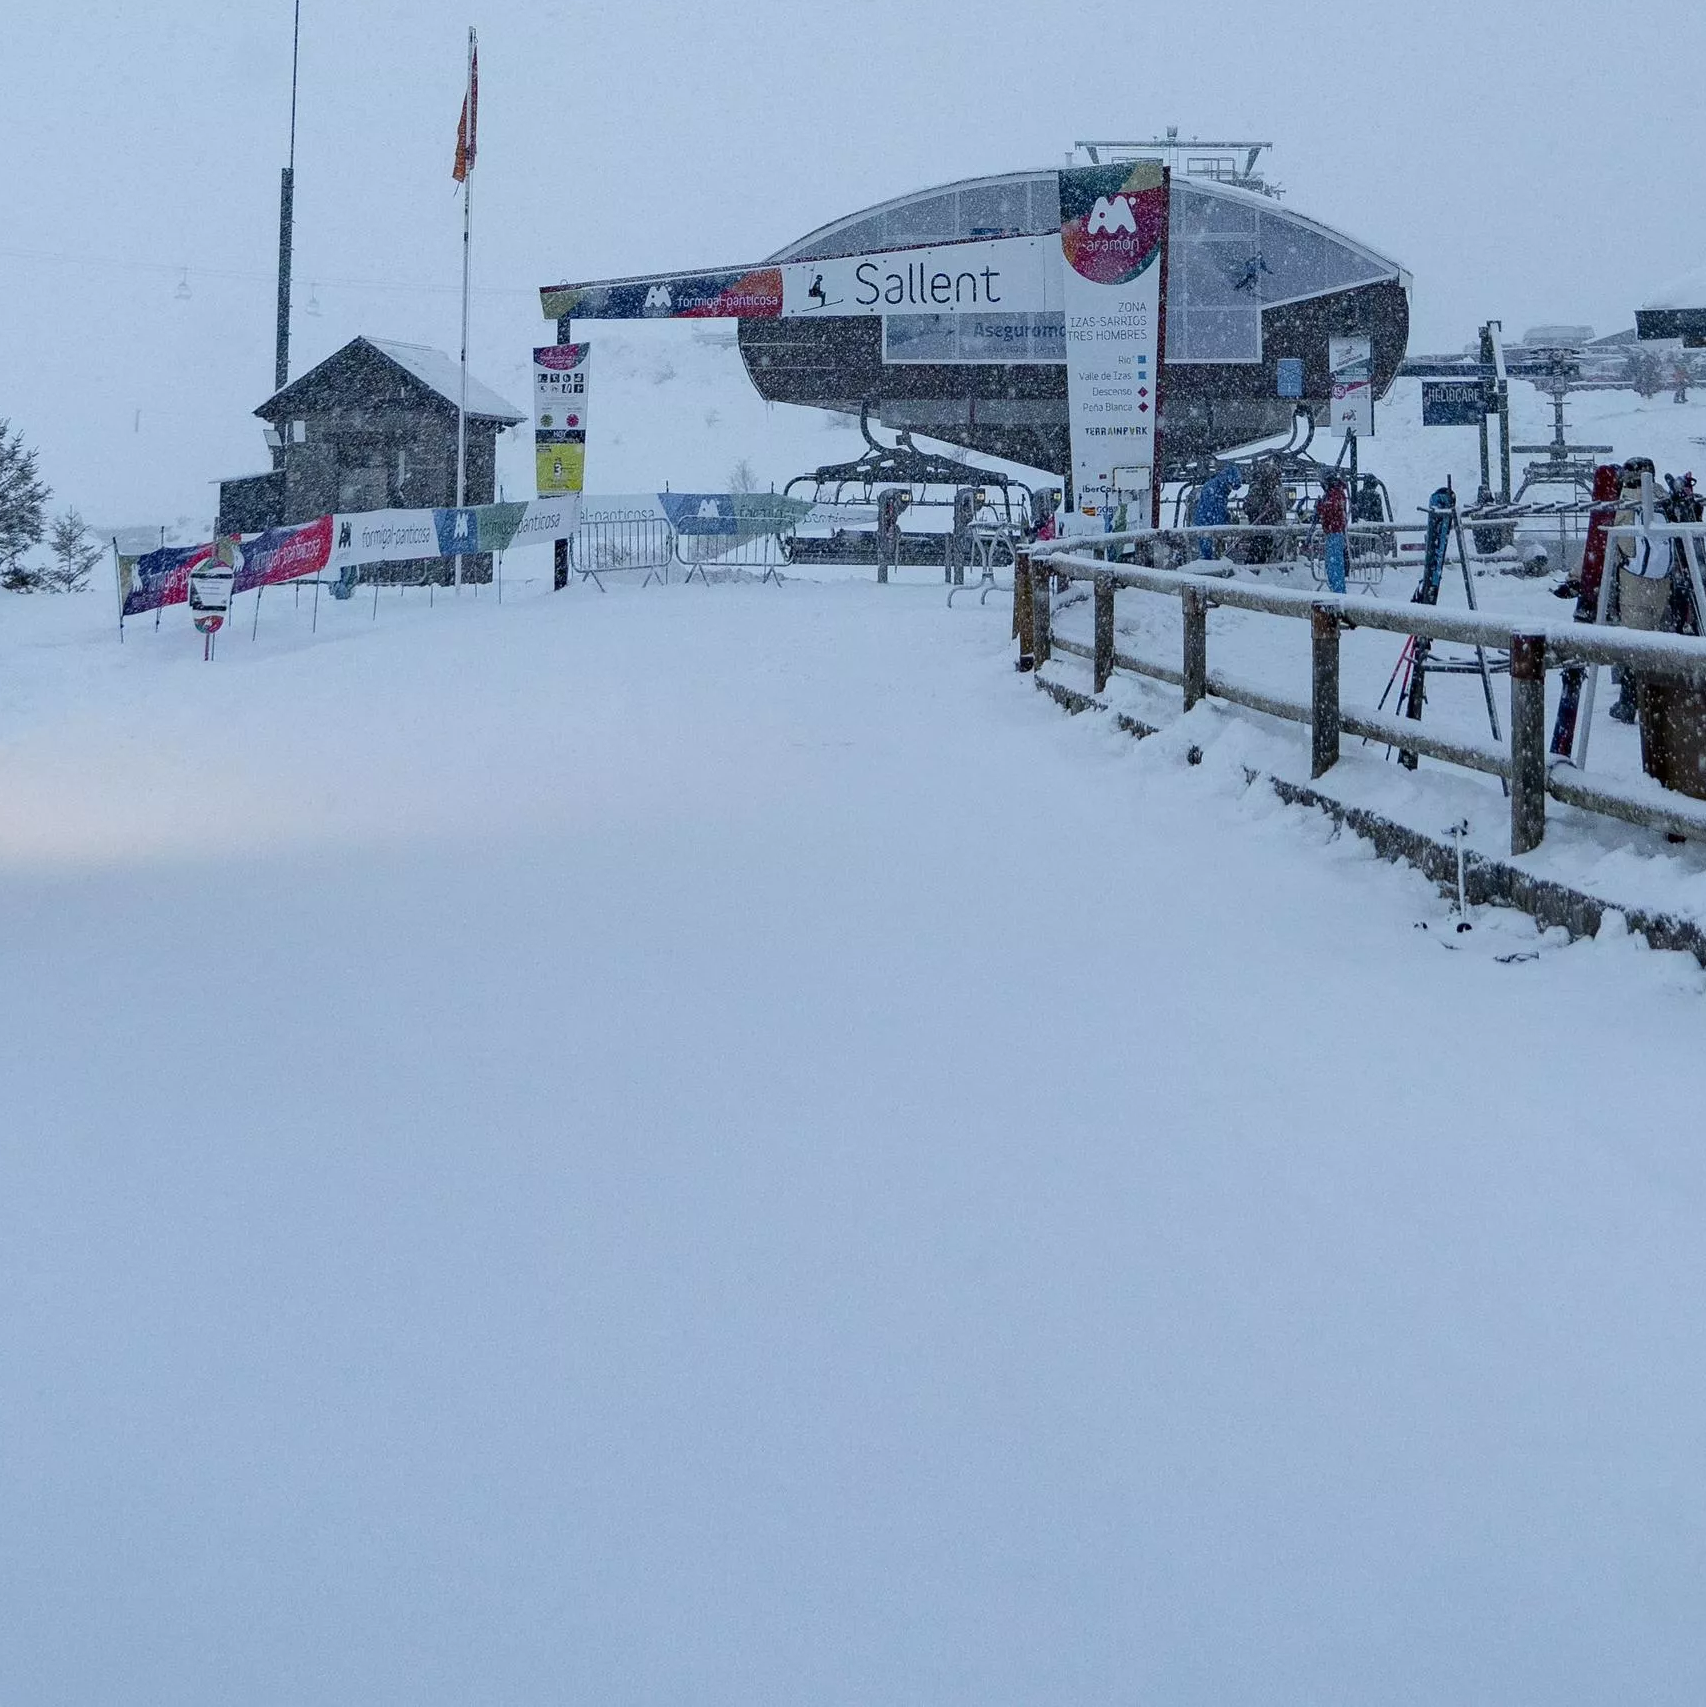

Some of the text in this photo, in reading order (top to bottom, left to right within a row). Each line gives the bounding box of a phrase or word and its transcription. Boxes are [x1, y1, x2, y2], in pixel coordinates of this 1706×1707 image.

[855, 262, 1002, 305] Sallent
[677, 293, 778, 309] formigal-panticosa
[1118, 302, 1147, 313] ZONA
[1070, 315, 1148, 328] IZAS-SARRIOS
[1068, 329, 1148, 341] TRES HOMBRES
[1078, 371, 1132, 381] Valle de Izas
[1092, 387, 1133, 397] Descenso
[1428, 388, 1480, 403] HELIOCARE
[1105, 402, 1133, 412] Blanca
[362, 523, 430, 550] formigal-panticosa
